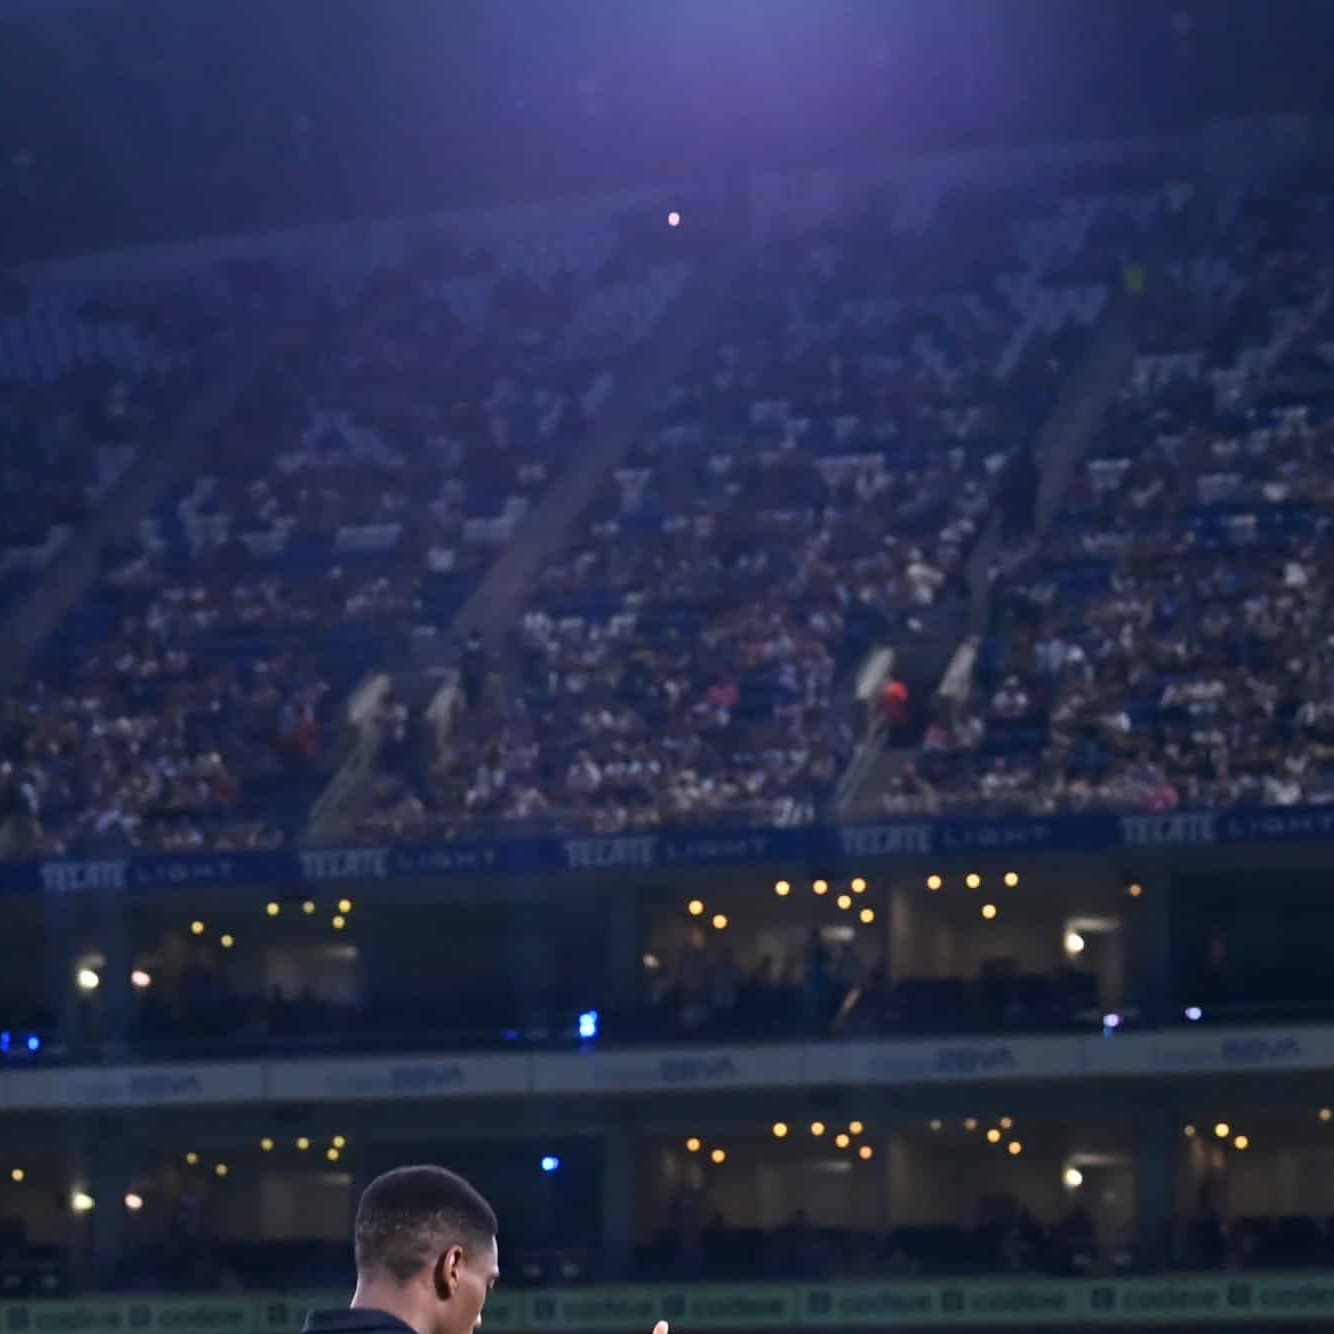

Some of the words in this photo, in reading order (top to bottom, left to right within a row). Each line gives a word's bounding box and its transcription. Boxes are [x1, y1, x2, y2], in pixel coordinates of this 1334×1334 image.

[839, 824, 932, 855] TECATE
[1119, 813, 1215, 847] TECATE
[298, 848, 389, 880] TECATE
[563, 836, 657, 868] TECATE
[39, 860, 127, 895] TECATE
